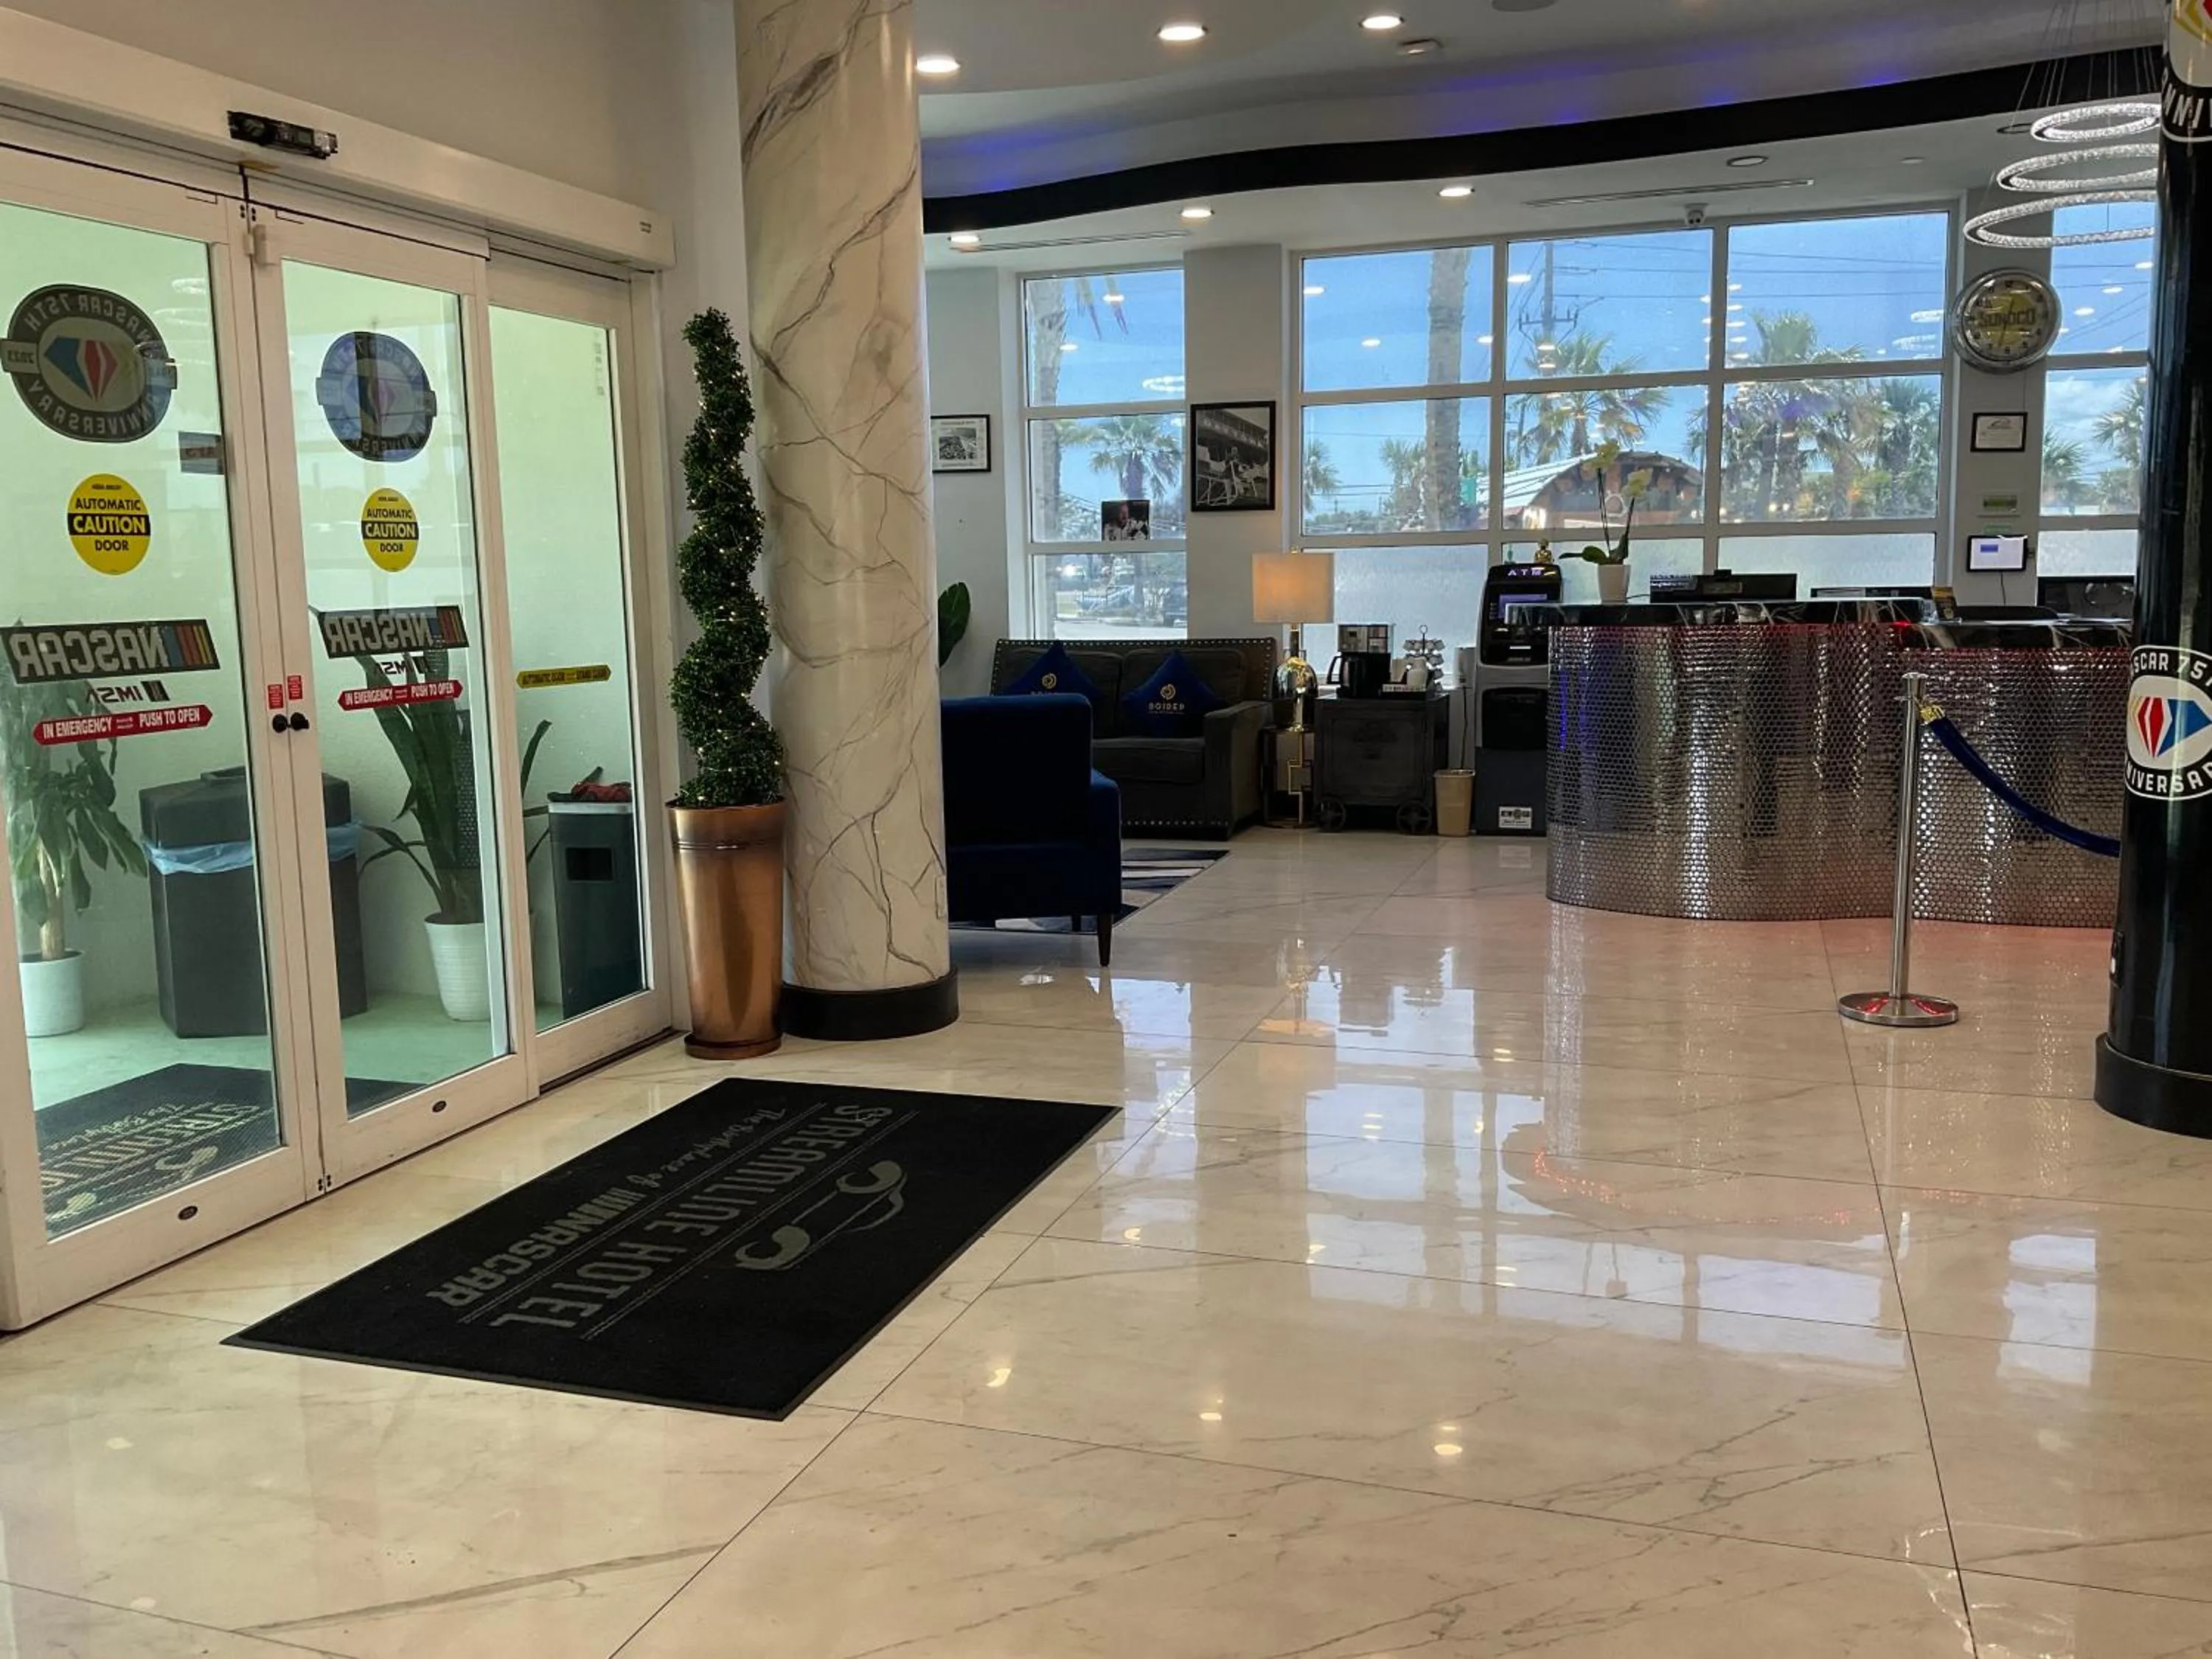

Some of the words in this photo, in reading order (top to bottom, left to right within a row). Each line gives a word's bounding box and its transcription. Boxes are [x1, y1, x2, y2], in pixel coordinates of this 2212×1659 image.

[75, 497, 142, 511] AUTOMATIC
[367, 508, 413, 519] AUTOMATIC
[74, 515, 147, 534] CAUTION
[365, 523, 416, 538] CAUTION
[94, 539, 129, 552] DOOR
[380, 542, 404, 552] DOOR
[1508, 568, 1542, 577] ATM
[2133, 652, 2169, 673] SCAR
[344, 692, 353, 706] IN
[354, 688, 393, 704] EMERGENCY
[411, 685, 428, 698] PUSH
[429, 684, 437, 695] TO
[438, 682, 455, 695] OPEN
[43, 723, 54, 739] IN
[56, 717, 112, 738] EMERGENCY
[139, 712, 163, 728] PUSH
[164, 710, 177, 725] TO
[178, 707, 201, 723] OPEN
[2126, 761, 2212, 794] NIVERSAR
[41, 1103, 260, 1189] STREAMLIN
[643, 1105, 894, 1237] STREAMLINE
[425, 1210, 606, 1307] NASCAR
[488, 1241, 688, 1328] HOTEL
